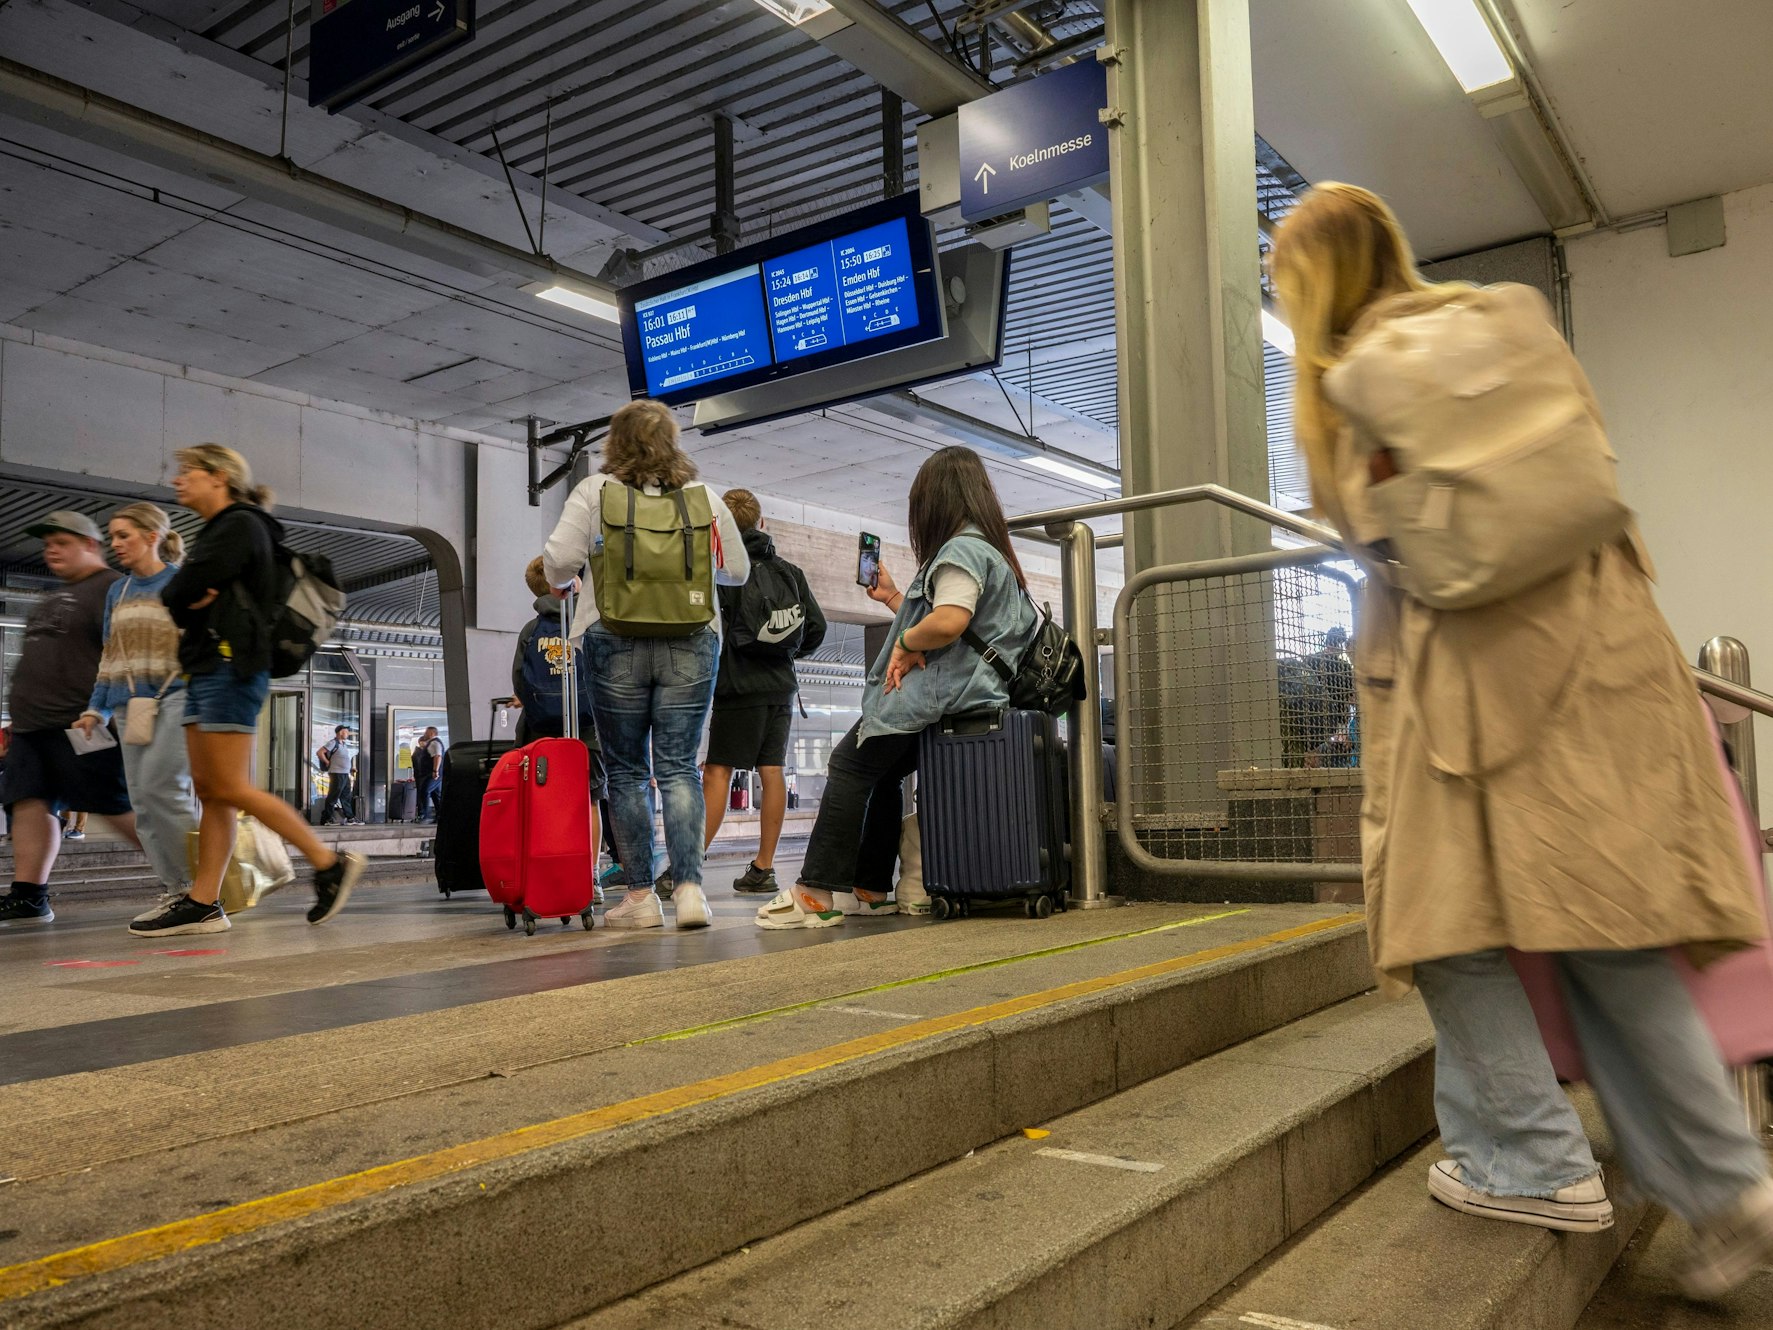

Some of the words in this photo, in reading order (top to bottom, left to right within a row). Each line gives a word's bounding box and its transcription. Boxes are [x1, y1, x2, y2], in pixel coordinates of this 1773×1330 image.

[386, 4, 420, 32] Ausgang
[1010, 134, 1092, 171] Koelnmesse
[841, 254, 862, 269] 15:50
[865, 250, 880, 260] 16:25
[772, 276, 791, 290] 15:24
[842, 273, 866, 286] Emden
[867, 266, 880, 279] Hbf
[878, 279, 897, 288] Duisburg
[773, 292, 800, 307] Dresden
[800, 286, 812, 299] Hbf
[869, 287, 898, 299] Gelsenkirchen
[775, 308, 791, 318] Solingen
[846, 305, 863, 314] Münster
[875, 298, 890, 306] Rheine
[643, 316, 665, 332] 16:01
[669, 311, 685, 320] 16:11
[776, 317, 788, 326] Hagen
[806, 317, 820, 325] Leipzig
[646, 332, 673, 349] Passau
[675, 324, 691, 340] Hbf
[768, 604, 801, 629] NIKE
